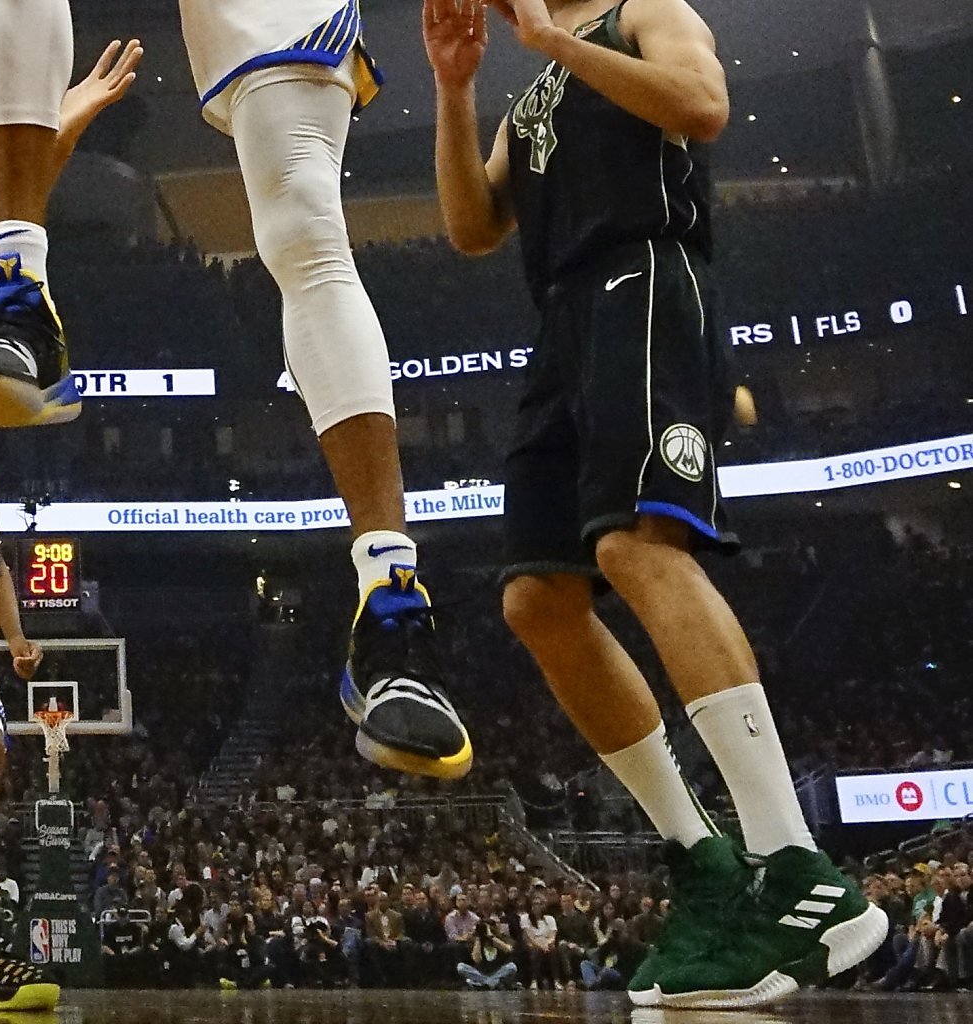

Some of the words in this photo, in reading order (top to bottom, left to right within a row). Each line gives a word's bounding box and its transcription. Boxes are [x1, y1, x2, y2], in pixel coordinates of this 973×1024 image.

[816, 311, 861, 337] FLS
[890, 300, 913, 324] 0
[389, 350, 503, 380] GOLDEN
[74, 373, 127, 394] QTR
[162, 373, 174, 392] 1
[824, 443, 973, 481] 1-800-DOCTOR
[108, 509, 178, 525] Official
[185, 509, 248, 525] health
[254, 512, 296, 524] care
[414, 497, 446, 514] the
[451, 492, 502, 512] Milw
[34, 543, 73, 562] 9:08
[30, 563, 68, 593] 20
[855, 793, 890, 806] BMO
[51, 919, 67, 933] THIS
[68, 919, 77, 933] IS
[52, 934, 69, 948] WHY
[52, 948, 64, 963] WE
[64, 948, 81, 963] PLAY
